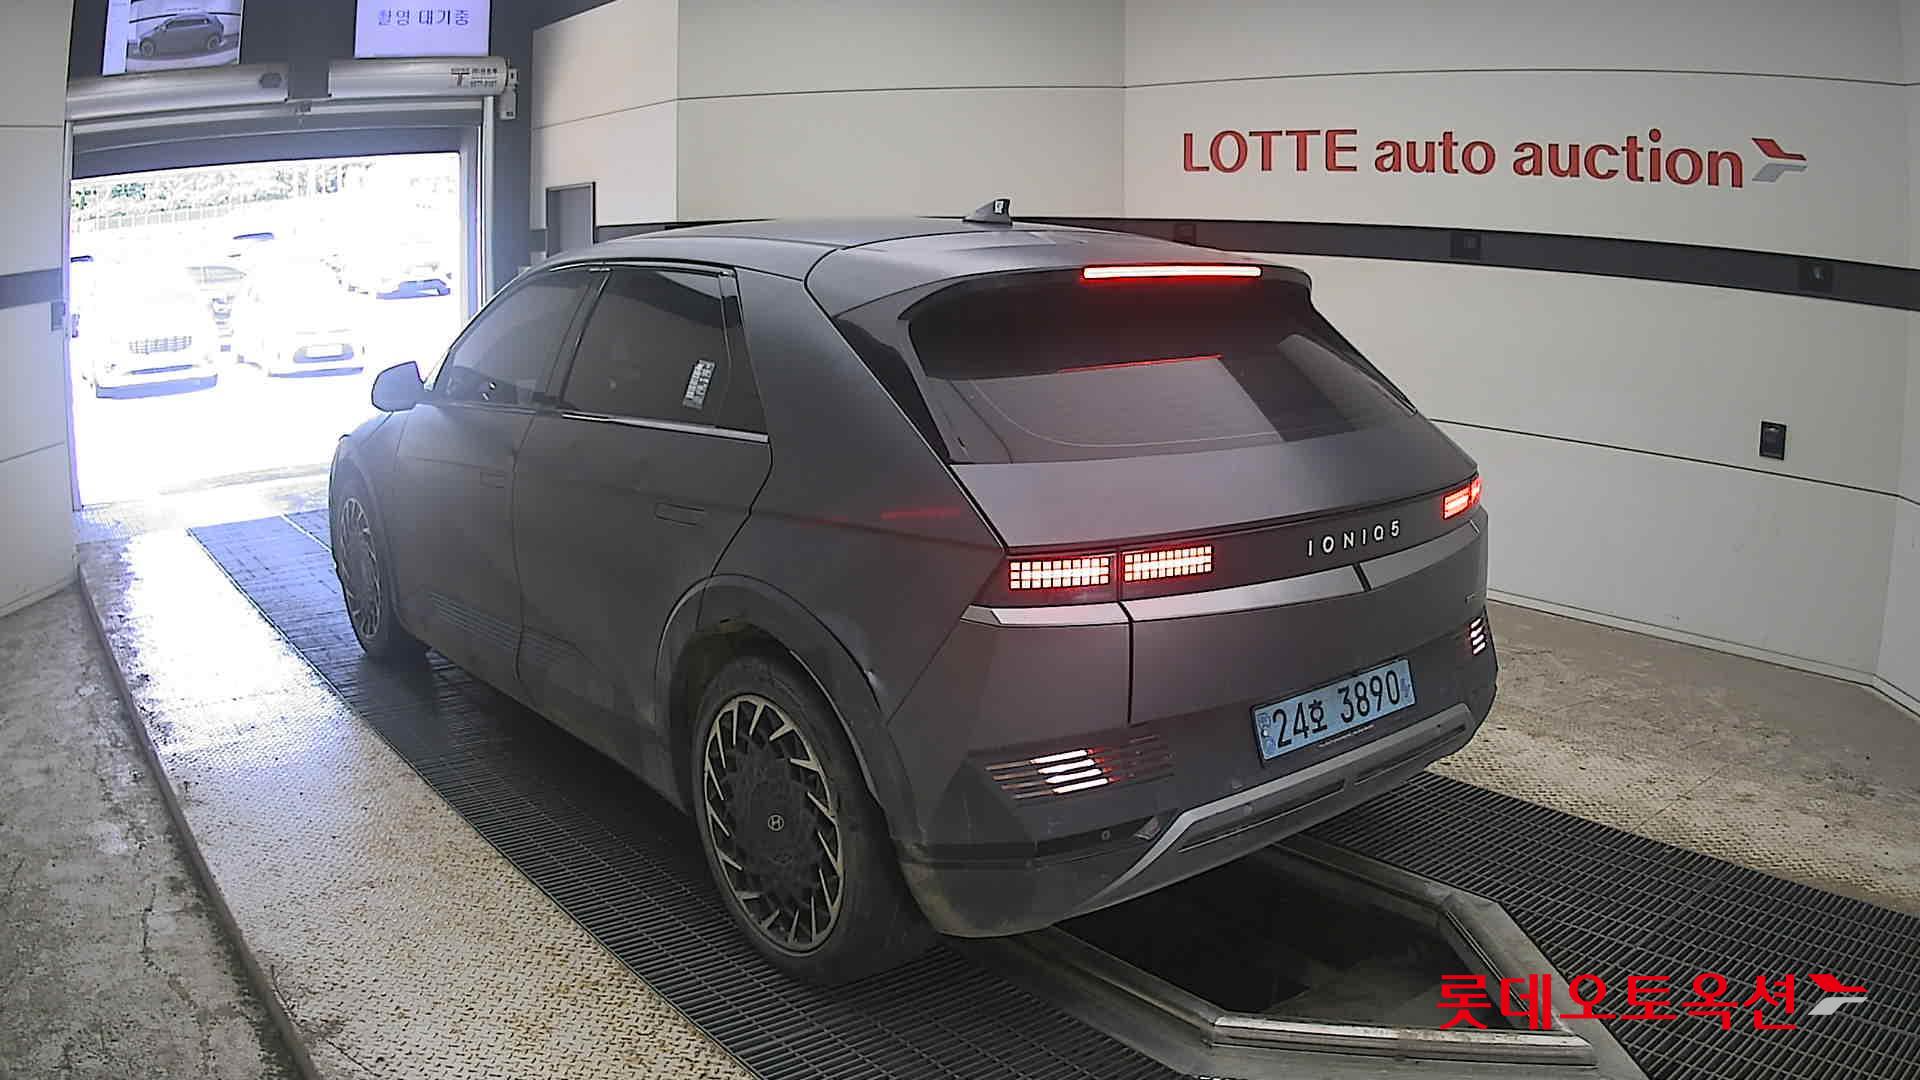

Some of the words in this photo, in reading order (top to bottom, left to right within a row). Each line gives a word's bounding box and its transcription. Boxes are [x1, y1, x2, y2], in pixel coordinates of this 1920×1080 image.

[418, 9, 470, 26] 대기중
[1183, 129, 1358, 173] LOTTE
[1374, 131, 1497, 175] auto
[1512, 128, 1745, 188] auction
[1272, 699, 1328, 749] 24호
[1337, 669, 1401, 724] 3890
